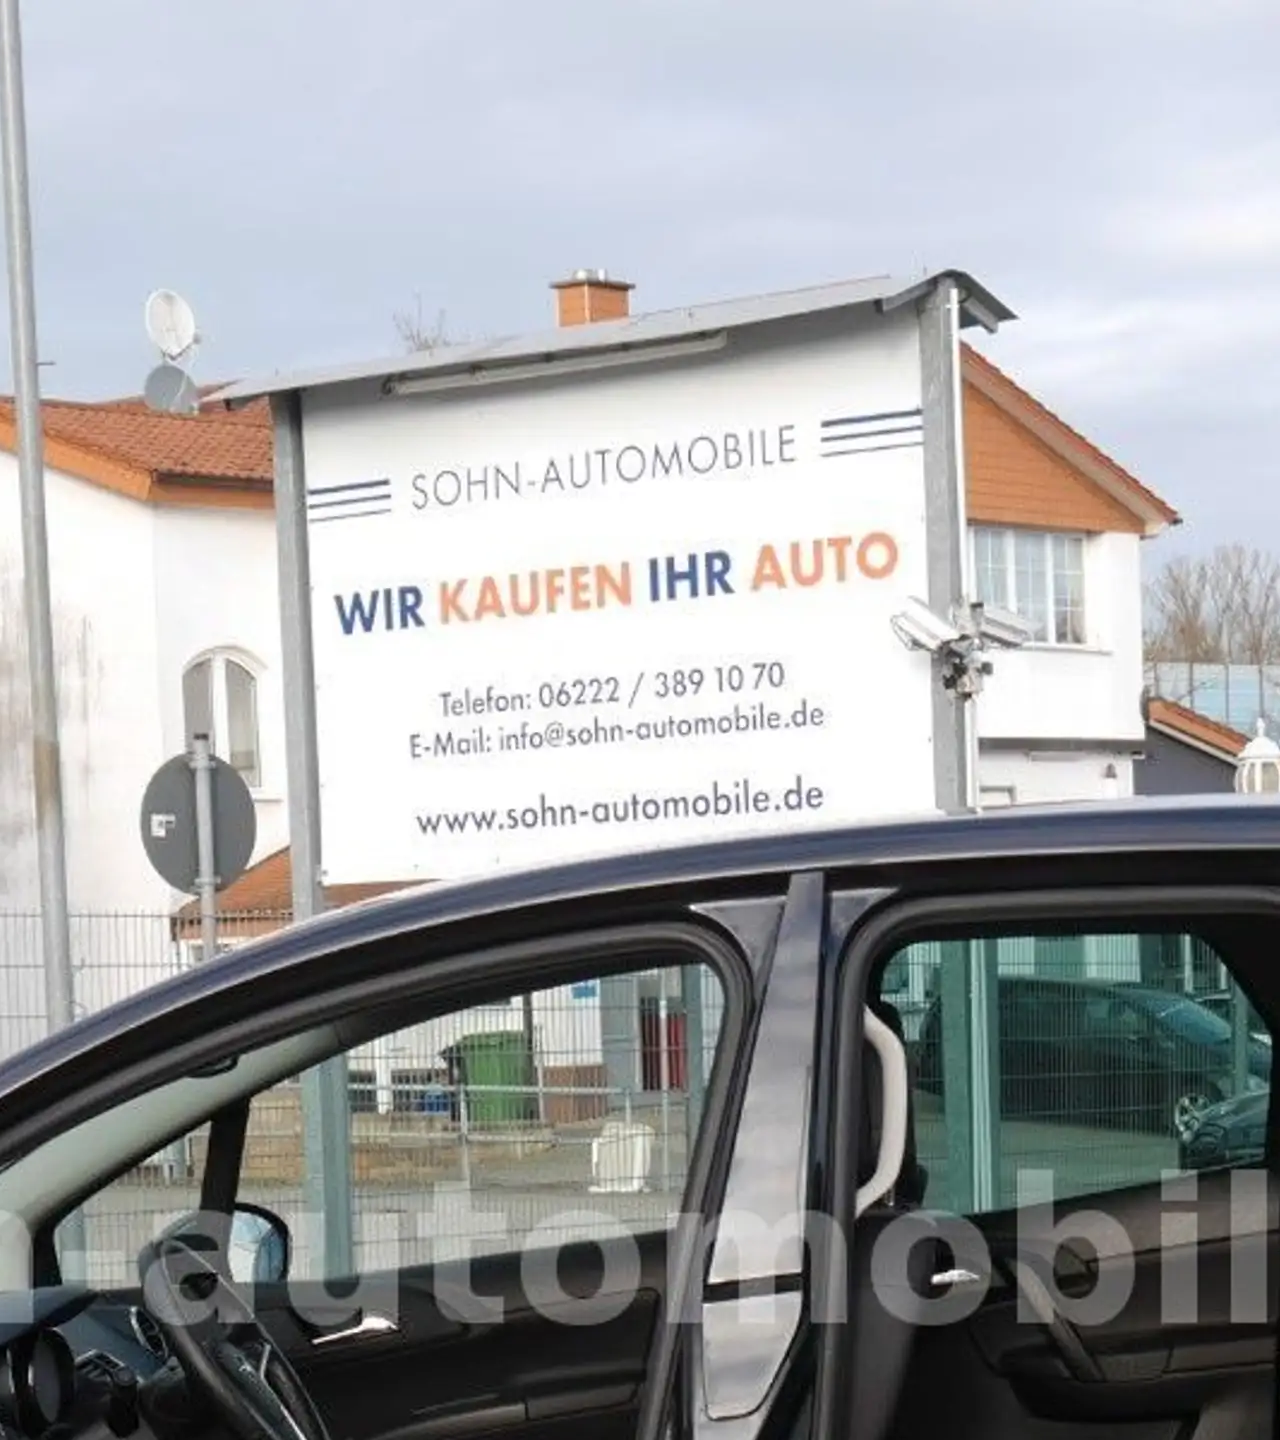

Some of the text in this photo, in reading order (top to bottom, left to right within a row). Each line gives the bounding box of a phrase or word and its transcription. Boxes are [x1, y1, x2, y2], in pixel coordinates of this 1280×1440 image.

[412, 424, 796, 510] SOHN-AUTOMOBILE
[334, 531, 899, 635] WIR KAUFEN IHR AUTO
[439, 661, 785, 717] Telefon: 06222 / 389 10 70
[409, 698, 825, 759] E-Mail: info@sohn-automobile.de
[416, 775, 824, 835] www.sohn-automobile.de
